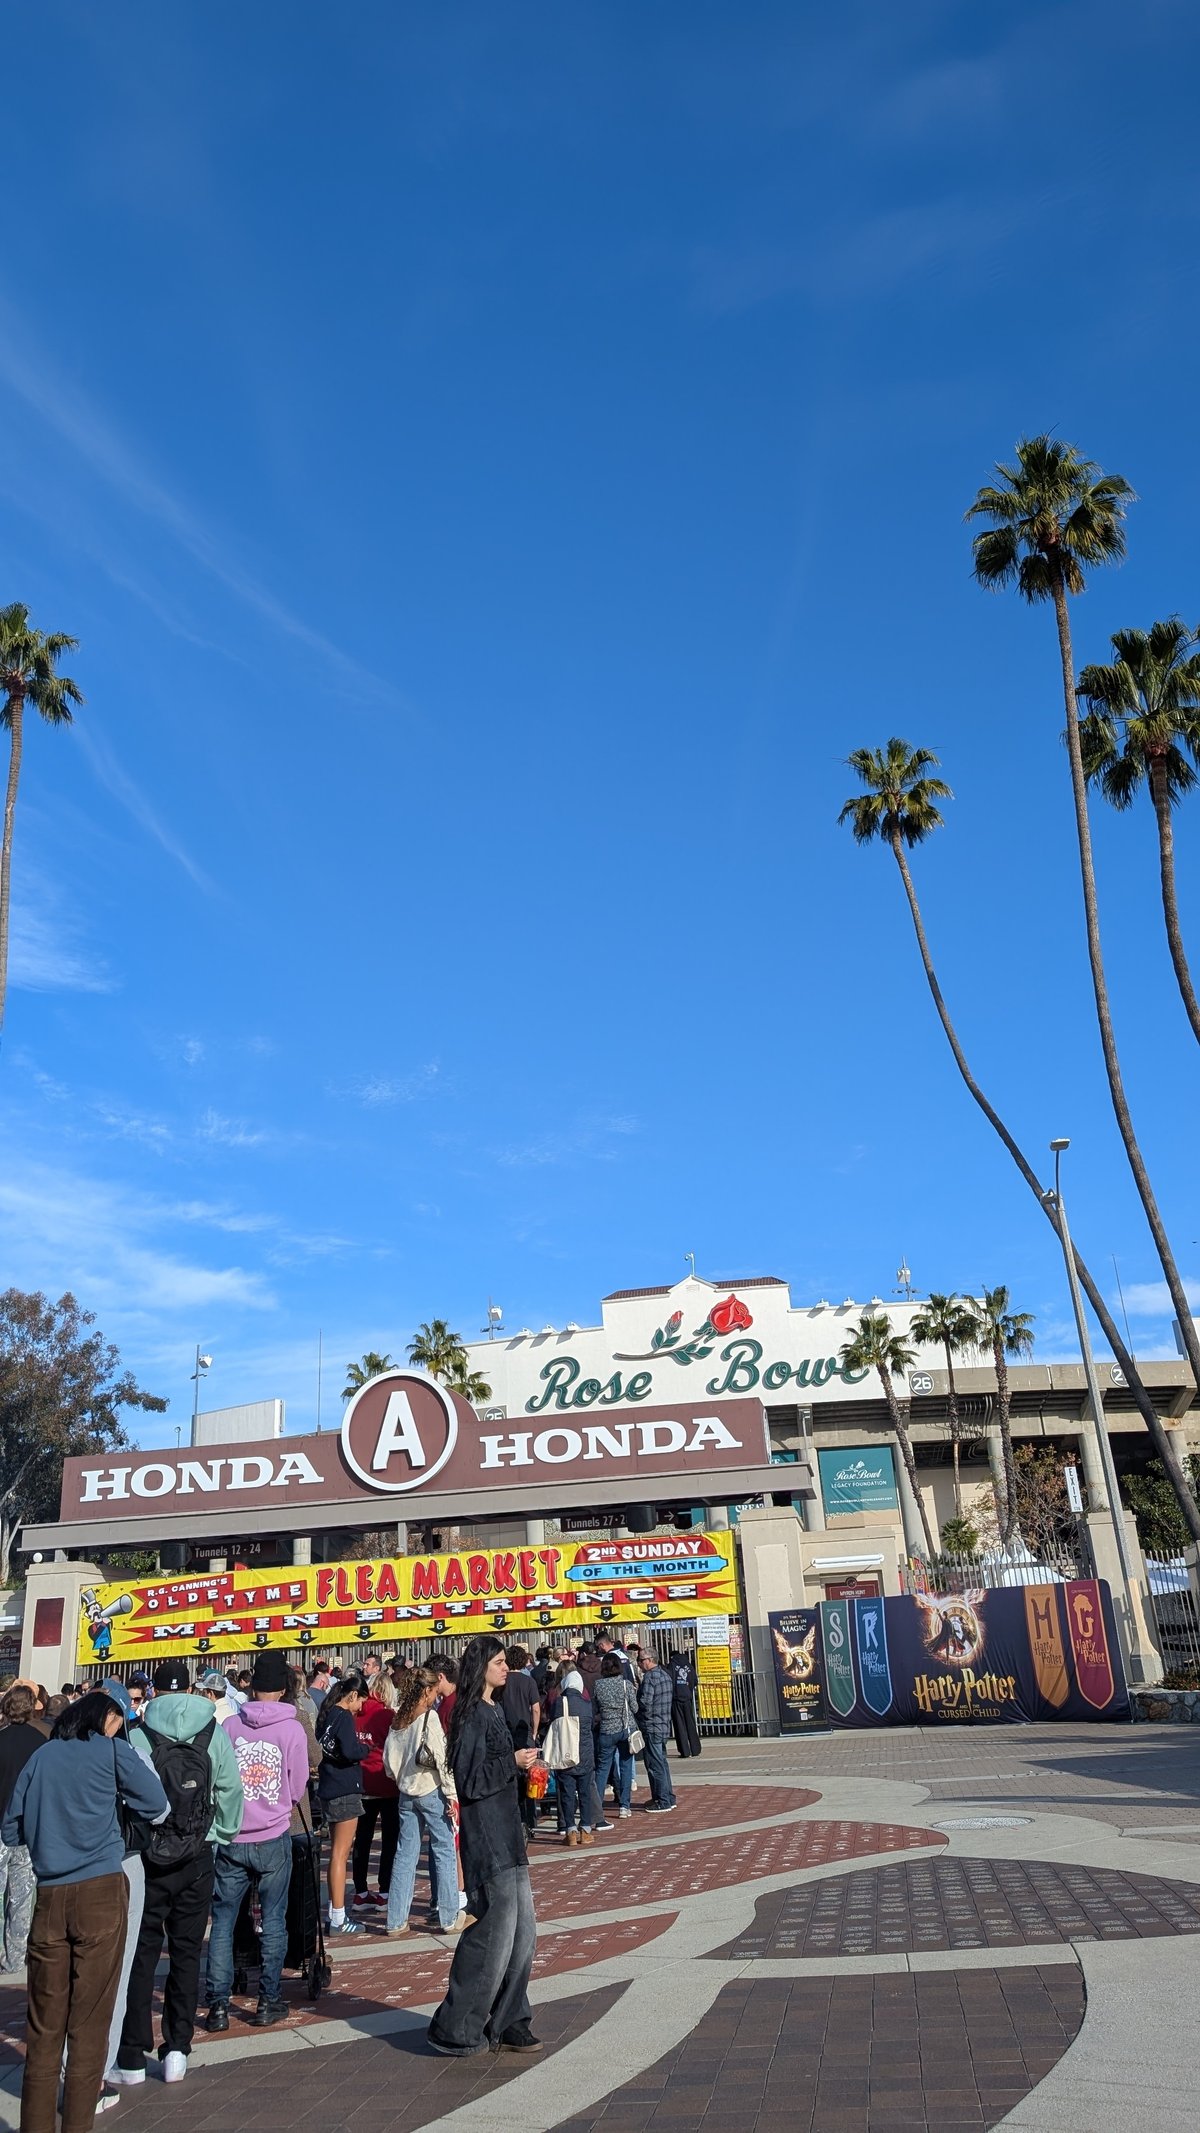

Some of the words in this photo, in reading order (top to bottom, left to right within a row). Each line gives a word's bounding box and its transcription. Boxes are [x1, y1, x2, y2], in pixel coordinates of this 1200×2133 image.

[1113, 1368, 1127, 1381] 2
[525, 1356, 652, 1413] Rose
[913, 1377, 931, 1390] 26
[373, 1391, 426, 1470] A
[480, 1416, 742, 1468] HONDA
[80, 1452, 325, 1502] HONDA
[834, 1470, 857, 1480] Rose
[857, 1469, 882, 1479] Bowl
[1068, 1467, 1077, 1504] EXIT
[566, 1517, 599, 1529] Tunnels
[603, 1515, 613, 1526] 27
[195, 1546, 228, 1558] Tunnels
[232, 1545, 241, 1555] 12
[249, 1543, 261, 1554] 24
[587, 1547, 617, 1561] 2ND
[621, 1541, 701, 1560] SUNDAY
[583, 1567, 602, 1577] OF
[612, 1565, 643, 1575] THE
[653, 1560, 709, 1573] MONTH
[316, 1564, 400, 1608] FLEA
[411, 1549, 562, 1600] MARKET
[147, 1586, 168, 1597] R.G.
[171, 1578, 228, 1592] CANNING'S
[148, 1589, 220, 1609] OLDE
[224, 1584, 302, 1606] TYME
[153, 1614, 320, 1638] MAIN
[356, 1584, 697, 1622] ENTRANCE
[1031, 1597, 1054, 1639] H
[258, 1636, 265, 1644] 3
[362, 1628, 368, 1636] 5
[497, 1617, 503, 1625] 7
[603, 1609, 610, 1617] 9
[648, 1606, 658, 1614] 10
[782, 1625, 807, 1633] MAGIC
[829, 1612, 844, 1652] S
[862, 1611, 878, 1650] R
[1034, 1641, 1053, 1656] Harry
[1076, 1639, 1095, 1654] Harry
[828, 1653, 844, 1667] Harry
[862, 1651, 879, 1665] Harry
[1040, 1653, 1062, 1664] Potter
[1084, 1650, 1105, 1663] Potter
[833, 1664, 850, 1676] Potter
[868, 1663, 886, 1675] Potter
[782, 1685, 800, 1698] Harry
[800, 1682, 820, 1695] Potter
[913, 1674, 962, 1712] Harry
[960, 1668, 1016, 1714] Potter
[938, 1710, 970, 1718] CURSED
[973, 1709, 1000, 1717] CHILD
